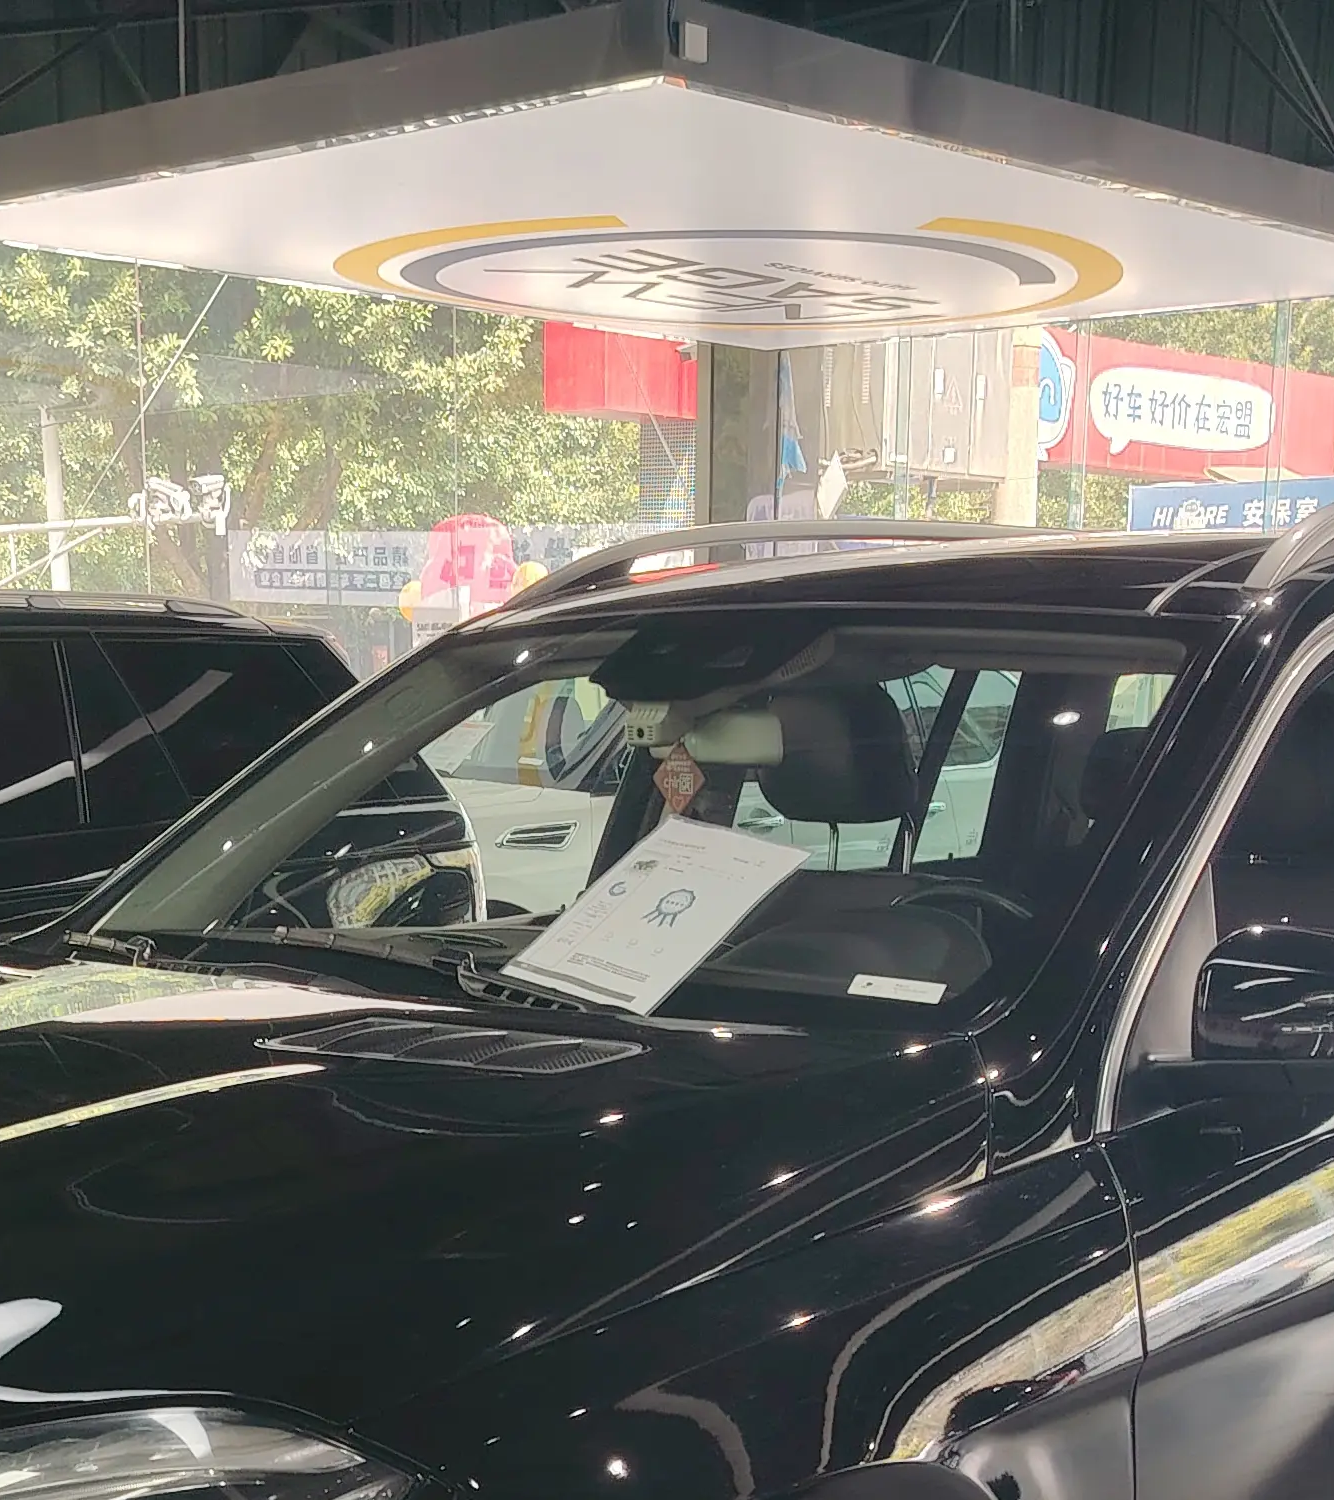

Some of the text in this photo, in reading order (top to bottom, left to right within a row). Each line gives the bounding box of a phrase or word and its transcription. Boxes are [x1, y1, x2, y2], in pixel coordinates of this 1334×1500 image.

[572, 249, 938, 312] SAGE
[764, 261, 917, 292] AUTO SERVICES
[1101, 381, 1254, 440] 好车好价在宏盟
[1243, 497, 1319, 526] 安保室
